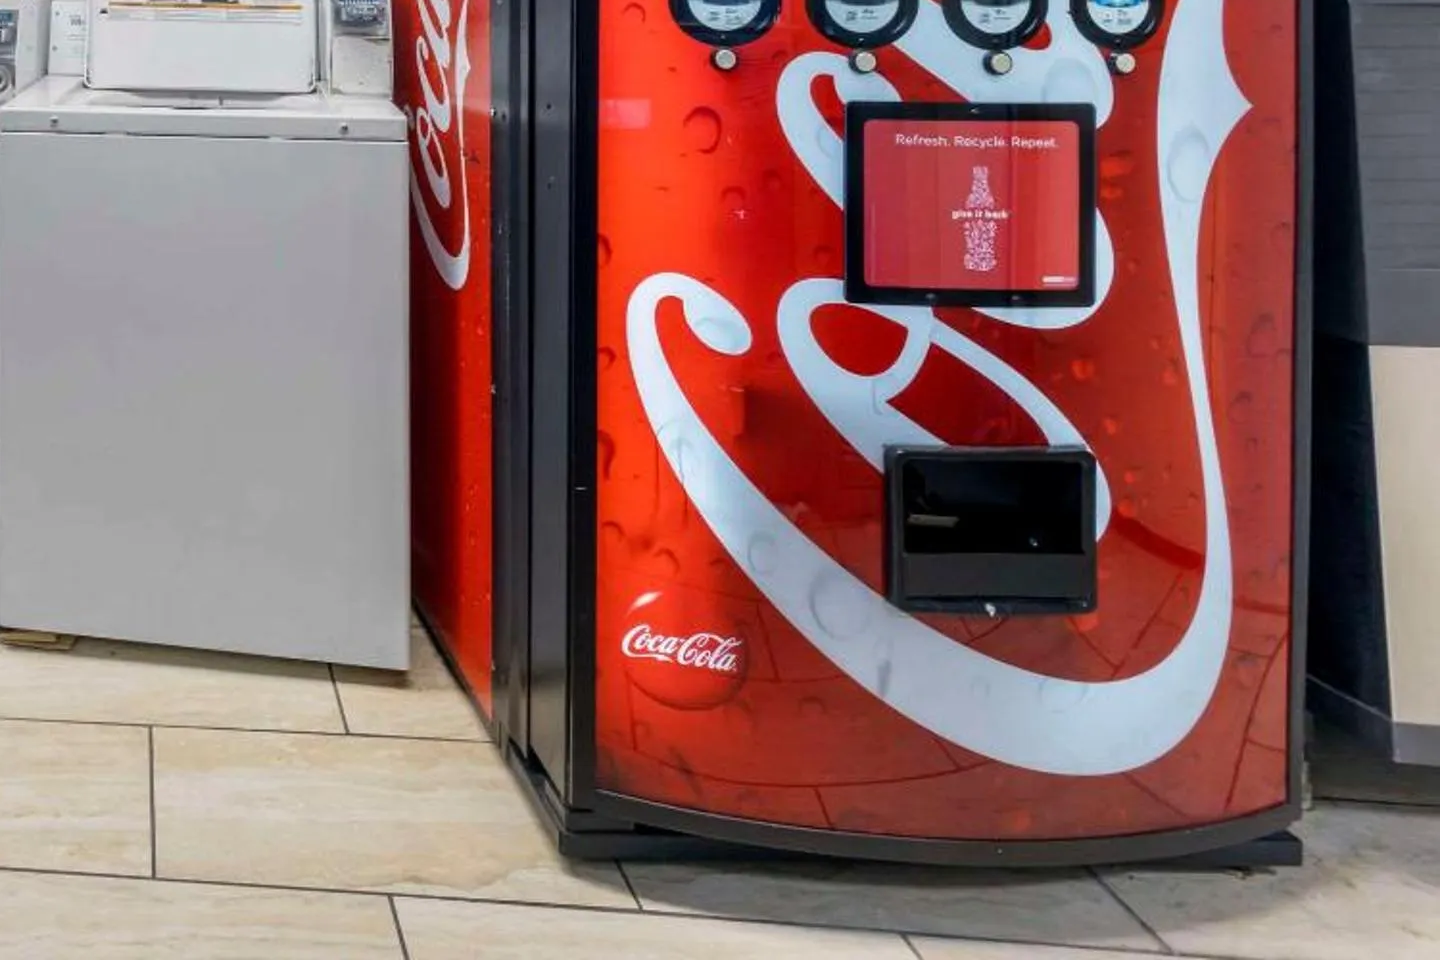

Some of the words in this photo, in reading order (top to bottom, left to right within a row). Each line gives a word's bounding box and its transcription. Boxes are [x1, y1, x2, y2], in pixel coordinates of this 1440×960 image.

[895, 133, 951, 147] Refresh.
[954, 135, 1006, 150] Recycle.
[621, 623, 743, 672] Coca-Cola
